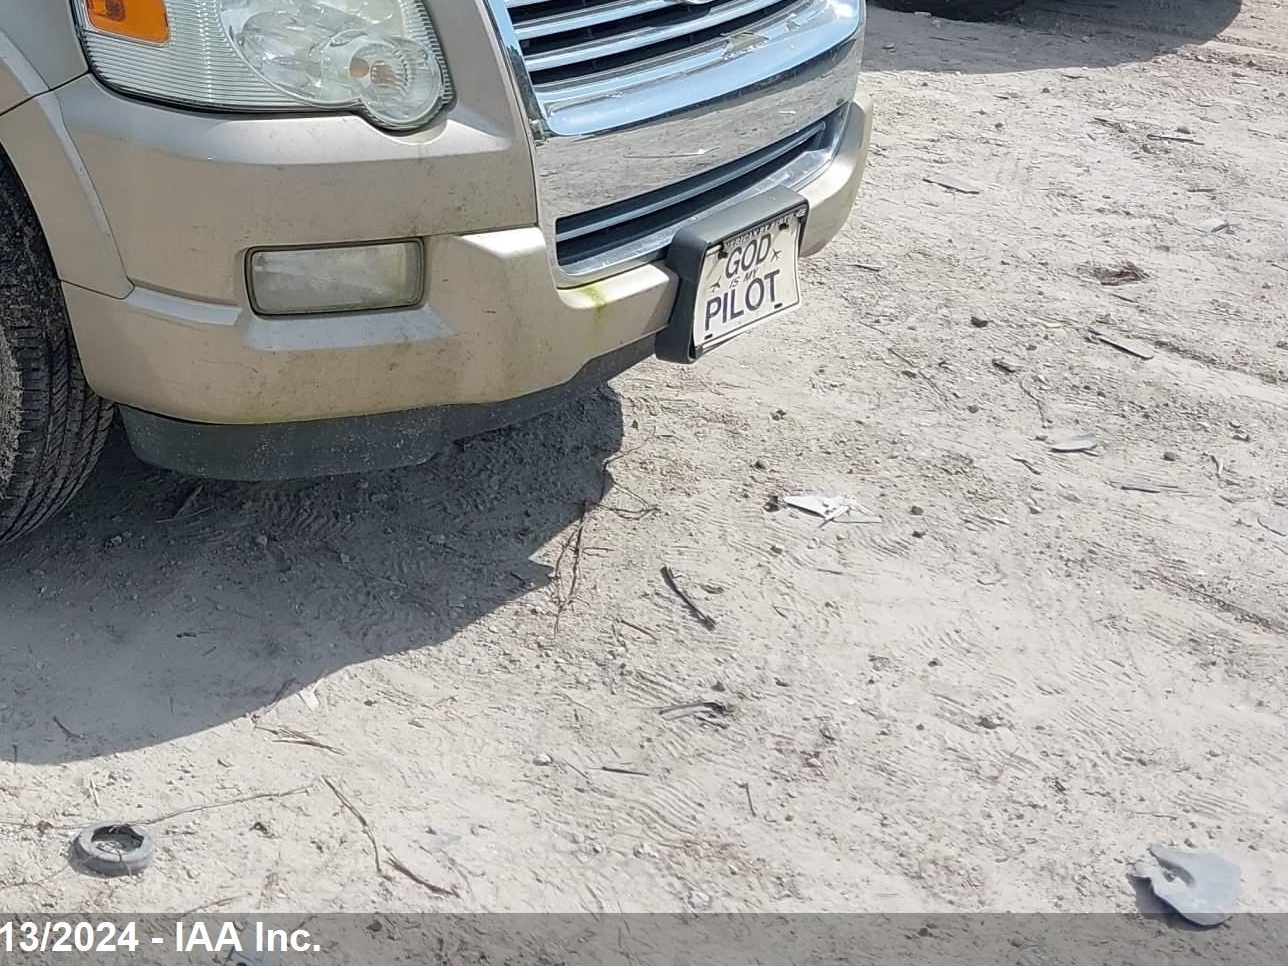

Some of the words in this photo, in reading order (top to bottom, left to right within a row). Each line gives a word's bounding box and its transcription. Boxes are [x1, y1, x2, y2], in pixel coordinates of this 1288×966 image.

[724, 233, 772, 280] GOD
[729, 276, 741, 290] IS
[743, 267, 760, 283] MY
[704, 268, 781, 332] PILOT
